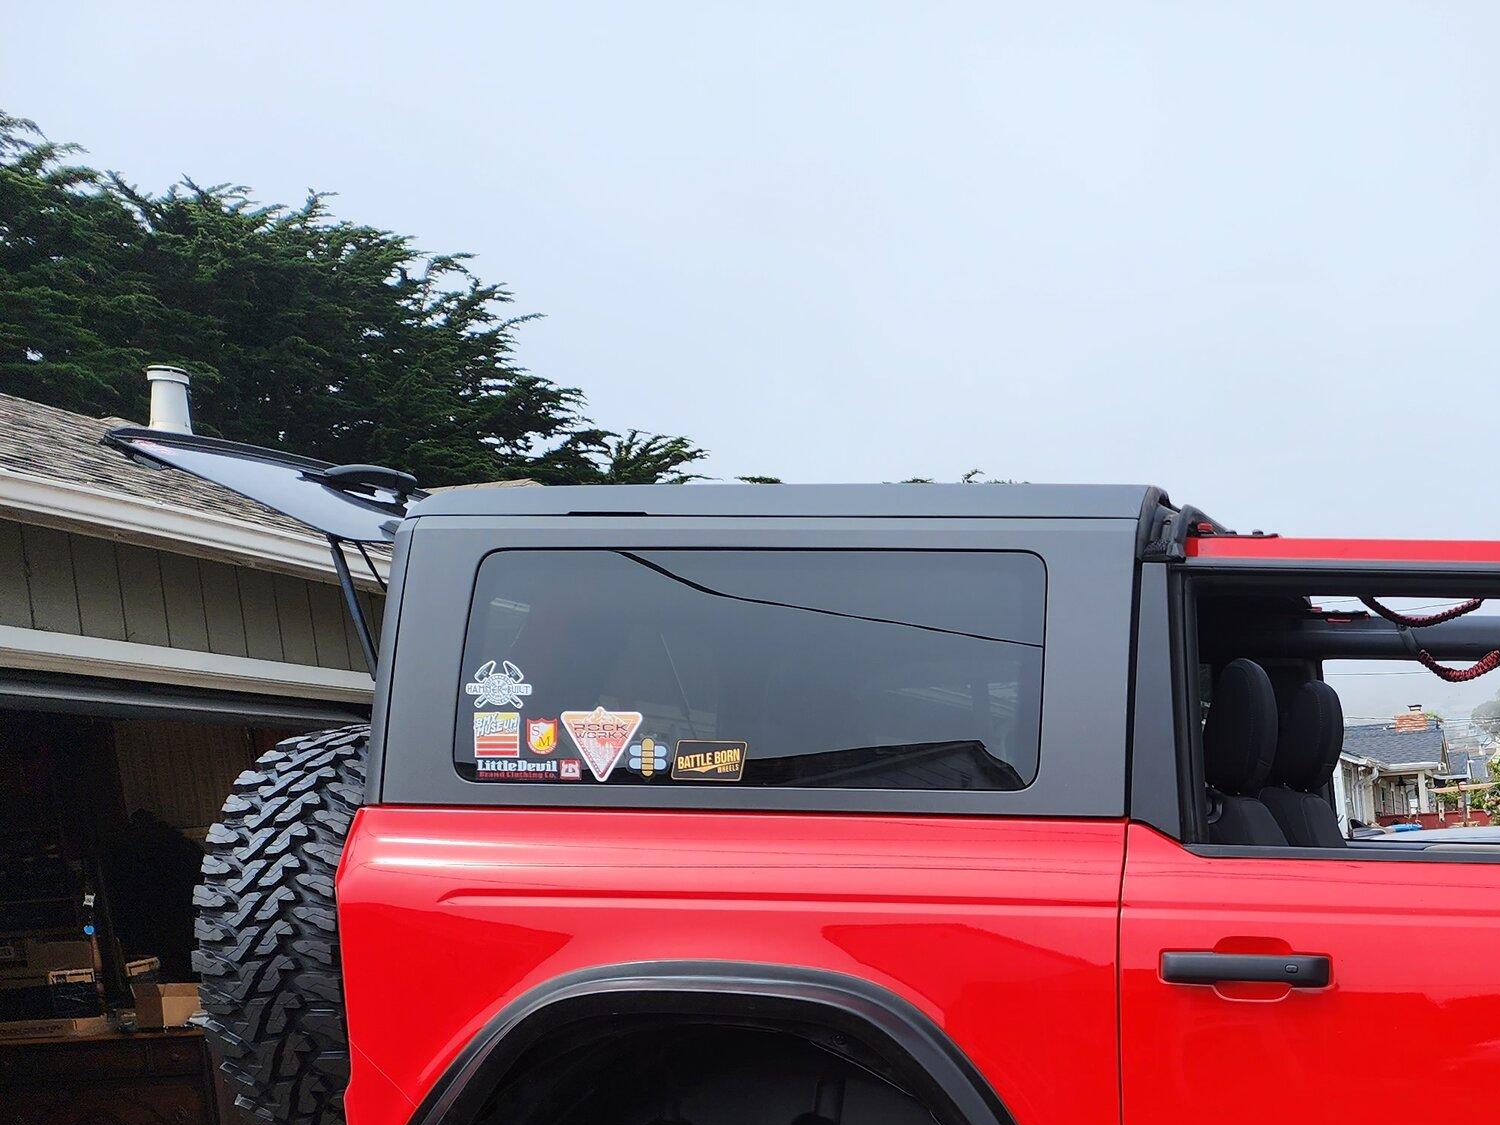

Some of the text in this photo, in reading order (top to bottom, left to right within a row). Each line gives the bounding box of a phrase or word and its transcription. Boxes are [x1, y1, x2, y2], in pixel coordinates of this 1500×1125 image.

[573, 723, 628, 732] ROCK
[677, 748, 740, 770] BATTLE BORN
[717, 763, 740, 774] WHEELS
